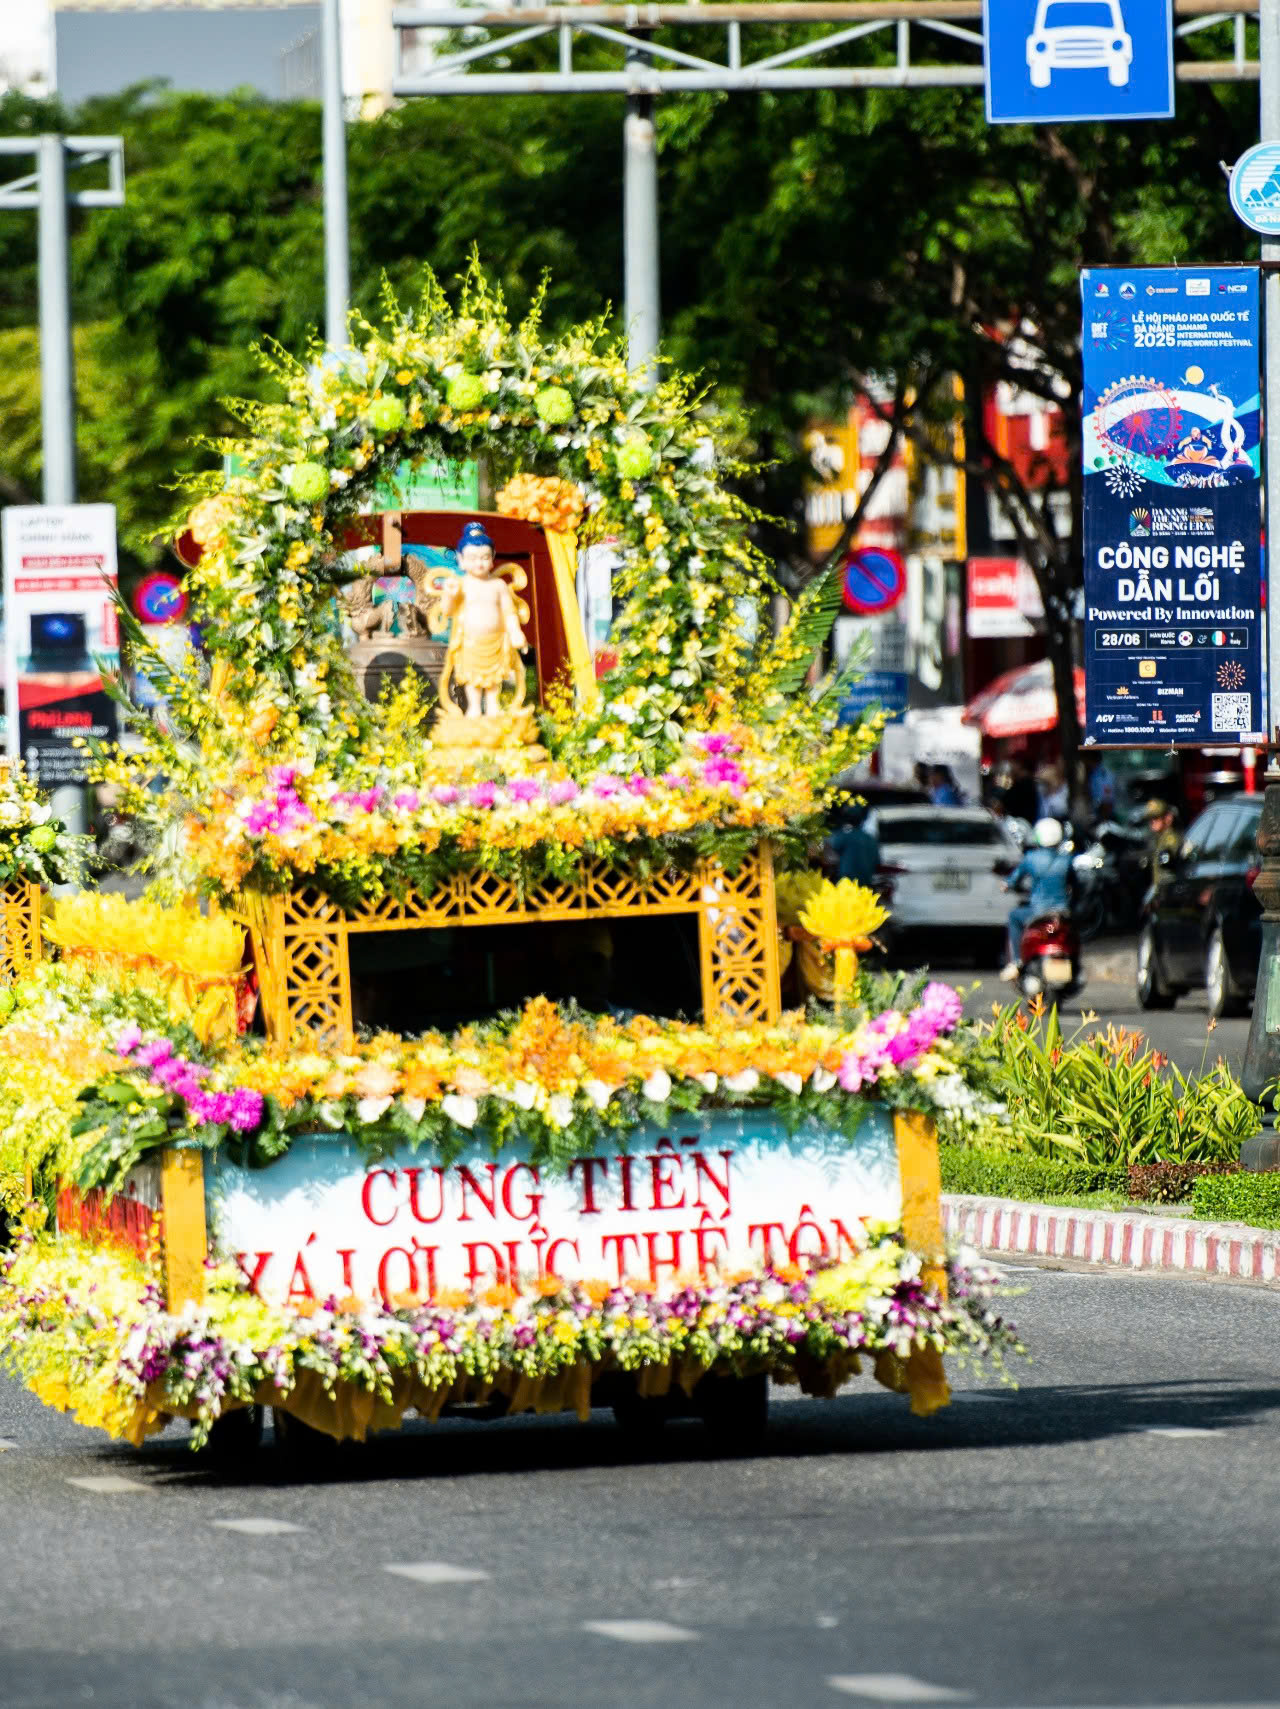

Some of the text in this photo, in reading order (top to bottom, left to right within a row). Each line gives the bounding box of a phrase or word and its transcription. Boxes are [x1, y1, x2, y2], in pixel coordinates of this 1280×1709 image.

[1146, 313, 1161, 325] HỘI
[1163, 311, 1188, 323] PHÁO
[1190, 314, 1208, 322] HOA
[1210, 311, 1235, 322] QUỐC
[1237, 310, 1250, 322] TẾ
[1177, 323, 1207, 331] DANANG
[1134, 333, 1175, 347] 2025
[1177, 331, 1233, 339] INTERNATIONAL
[1177, 339, 1253, 347] FIREWORKS FESTIVAL
[1152, 522, 1187, 531] RISING
[1098, 540, 1245, 575] CÔNG NGHỆ
[1118, 569, 1219, 602] DẪN LỐI
[1089, 606, 1255, 623] Powered By Innovation
[1102, 633, 1140, 647] 28/06
[361, 1162, 544, 1226] CUNG
[601, 1206, 731, 1286] THẾ
